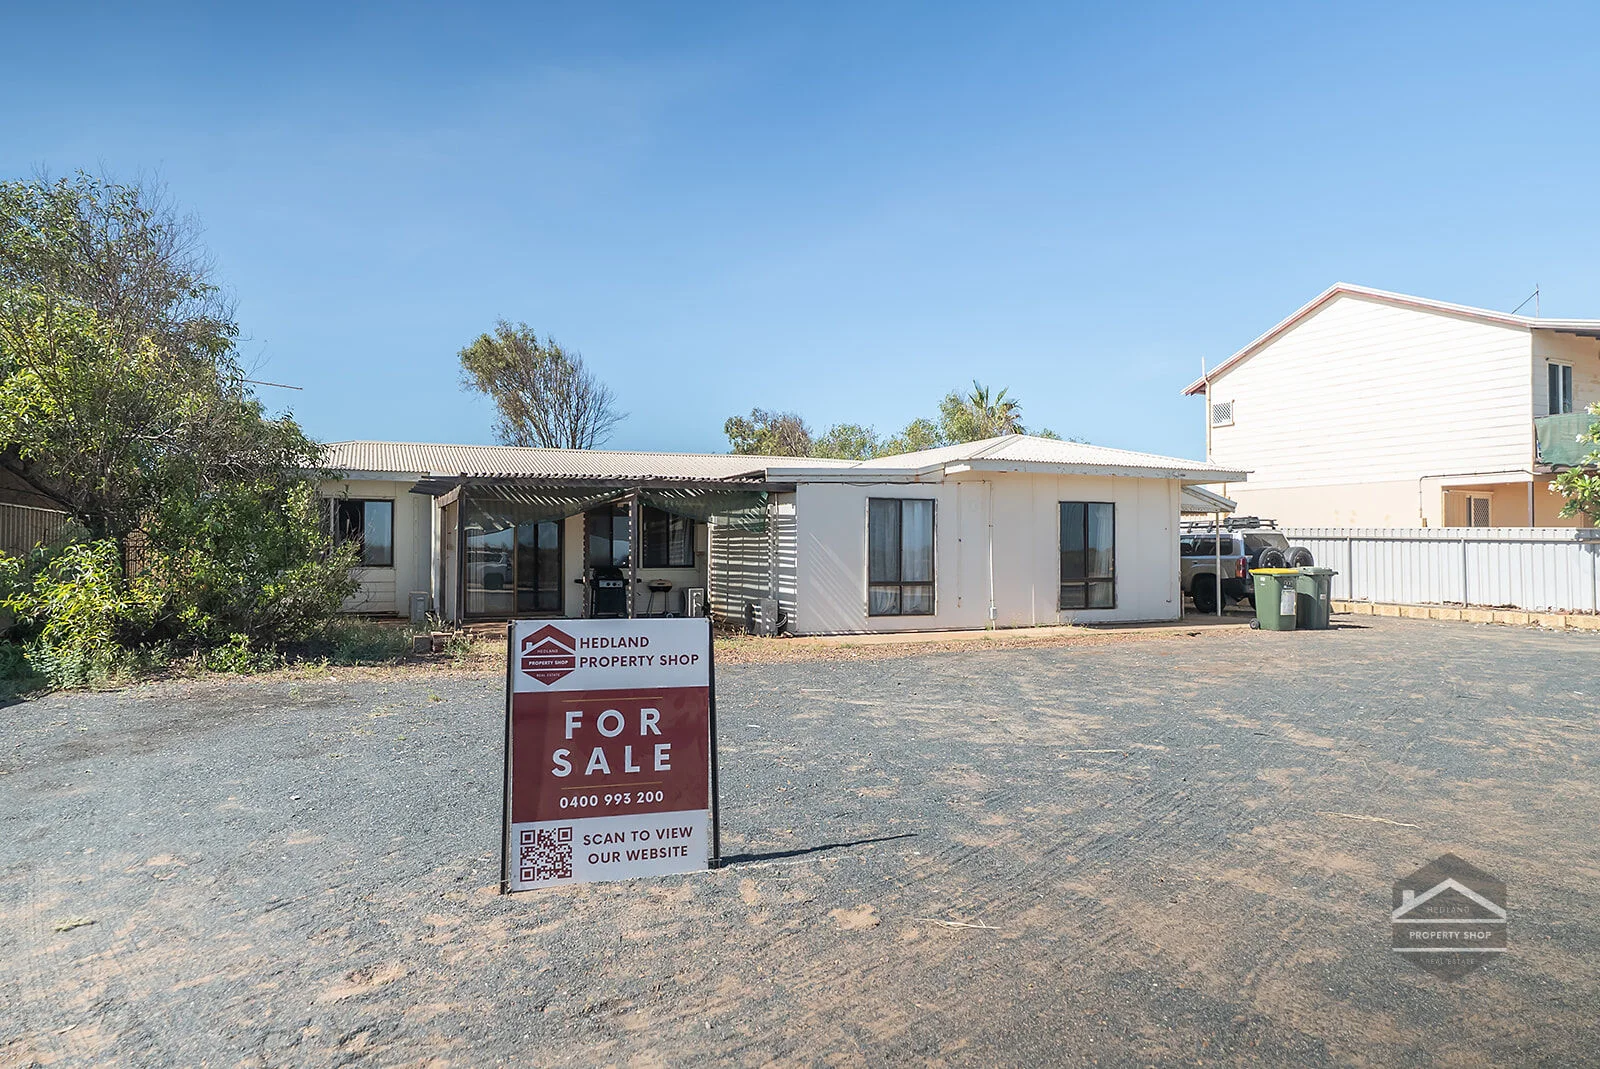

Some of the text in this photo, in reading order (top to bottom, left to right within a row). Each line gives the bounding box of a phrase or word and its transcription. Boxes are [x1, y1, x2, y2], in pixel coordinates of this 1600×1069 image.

[580, 636, 649, 649] HEDLAND
[580, 654, 699, 668] PROPERTY SHOP
[565, 708, 662, 740] FOR
[551, 743, 672, 777] SALE
[559, 790, 664, 809] 0400 993 200
[583, 826, 693, 845] SCAN TO VIEW
[588, 846, 688, 864] OUR WEBSITE
